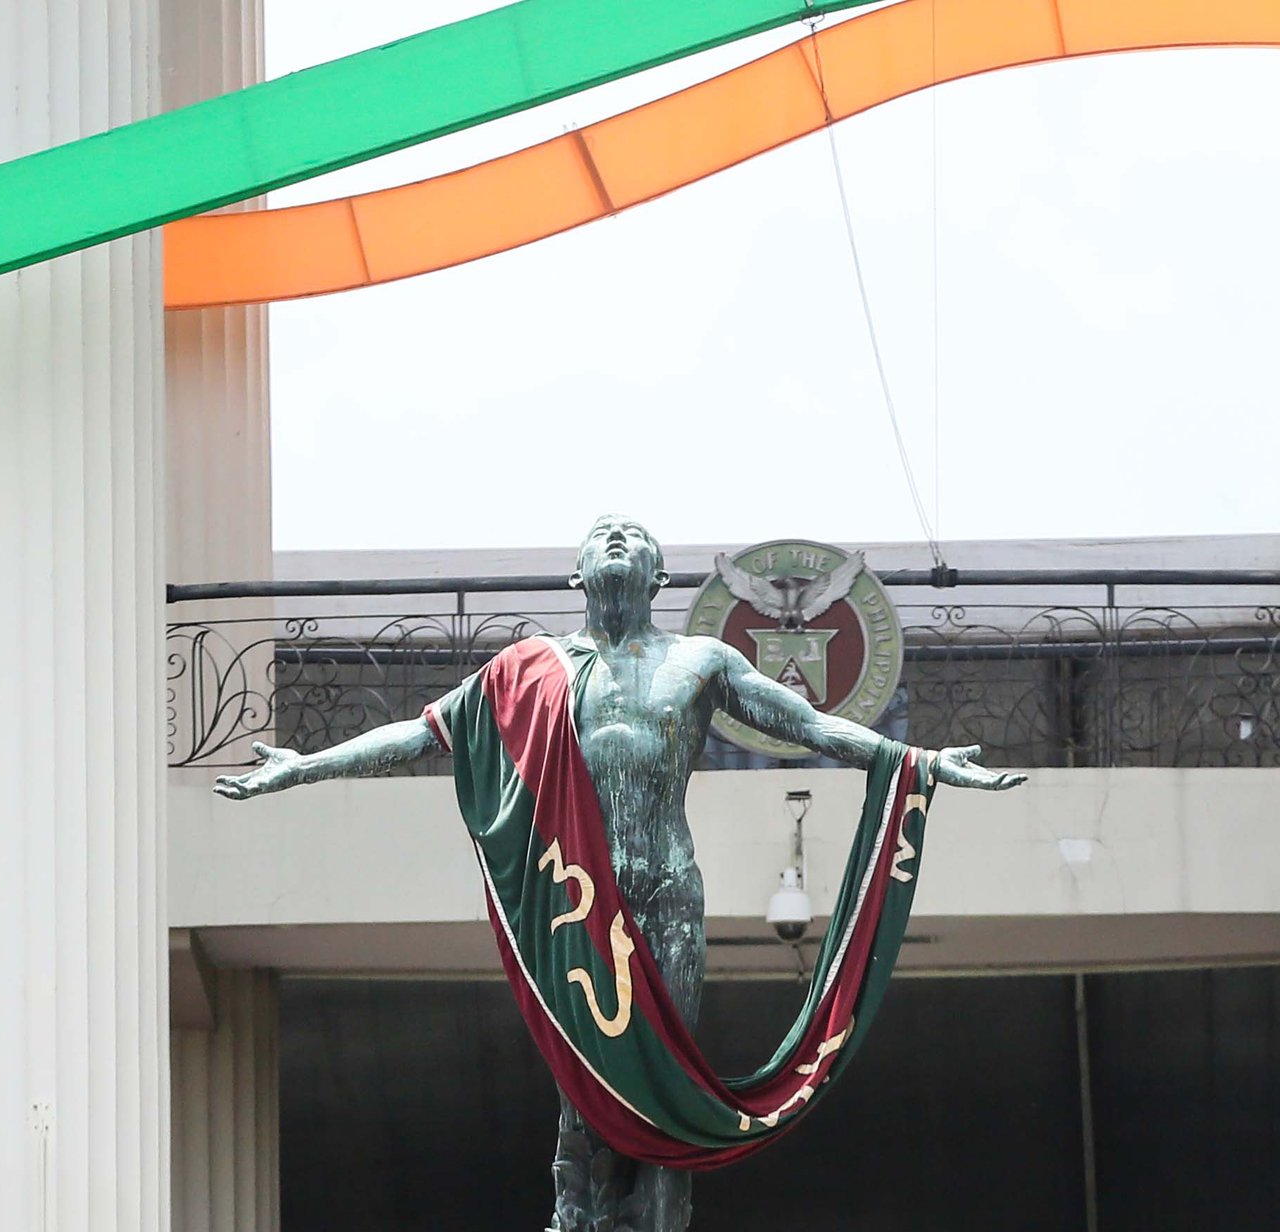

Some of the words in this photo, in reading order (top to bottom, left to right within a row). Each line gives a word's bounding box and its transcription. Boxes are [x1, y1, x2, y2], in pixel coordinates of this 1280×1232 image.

[751, 551, 779, 574] OF
[789, 549, 831, 573] THE
[847, 591, 892, 721] PHILIPPINE
